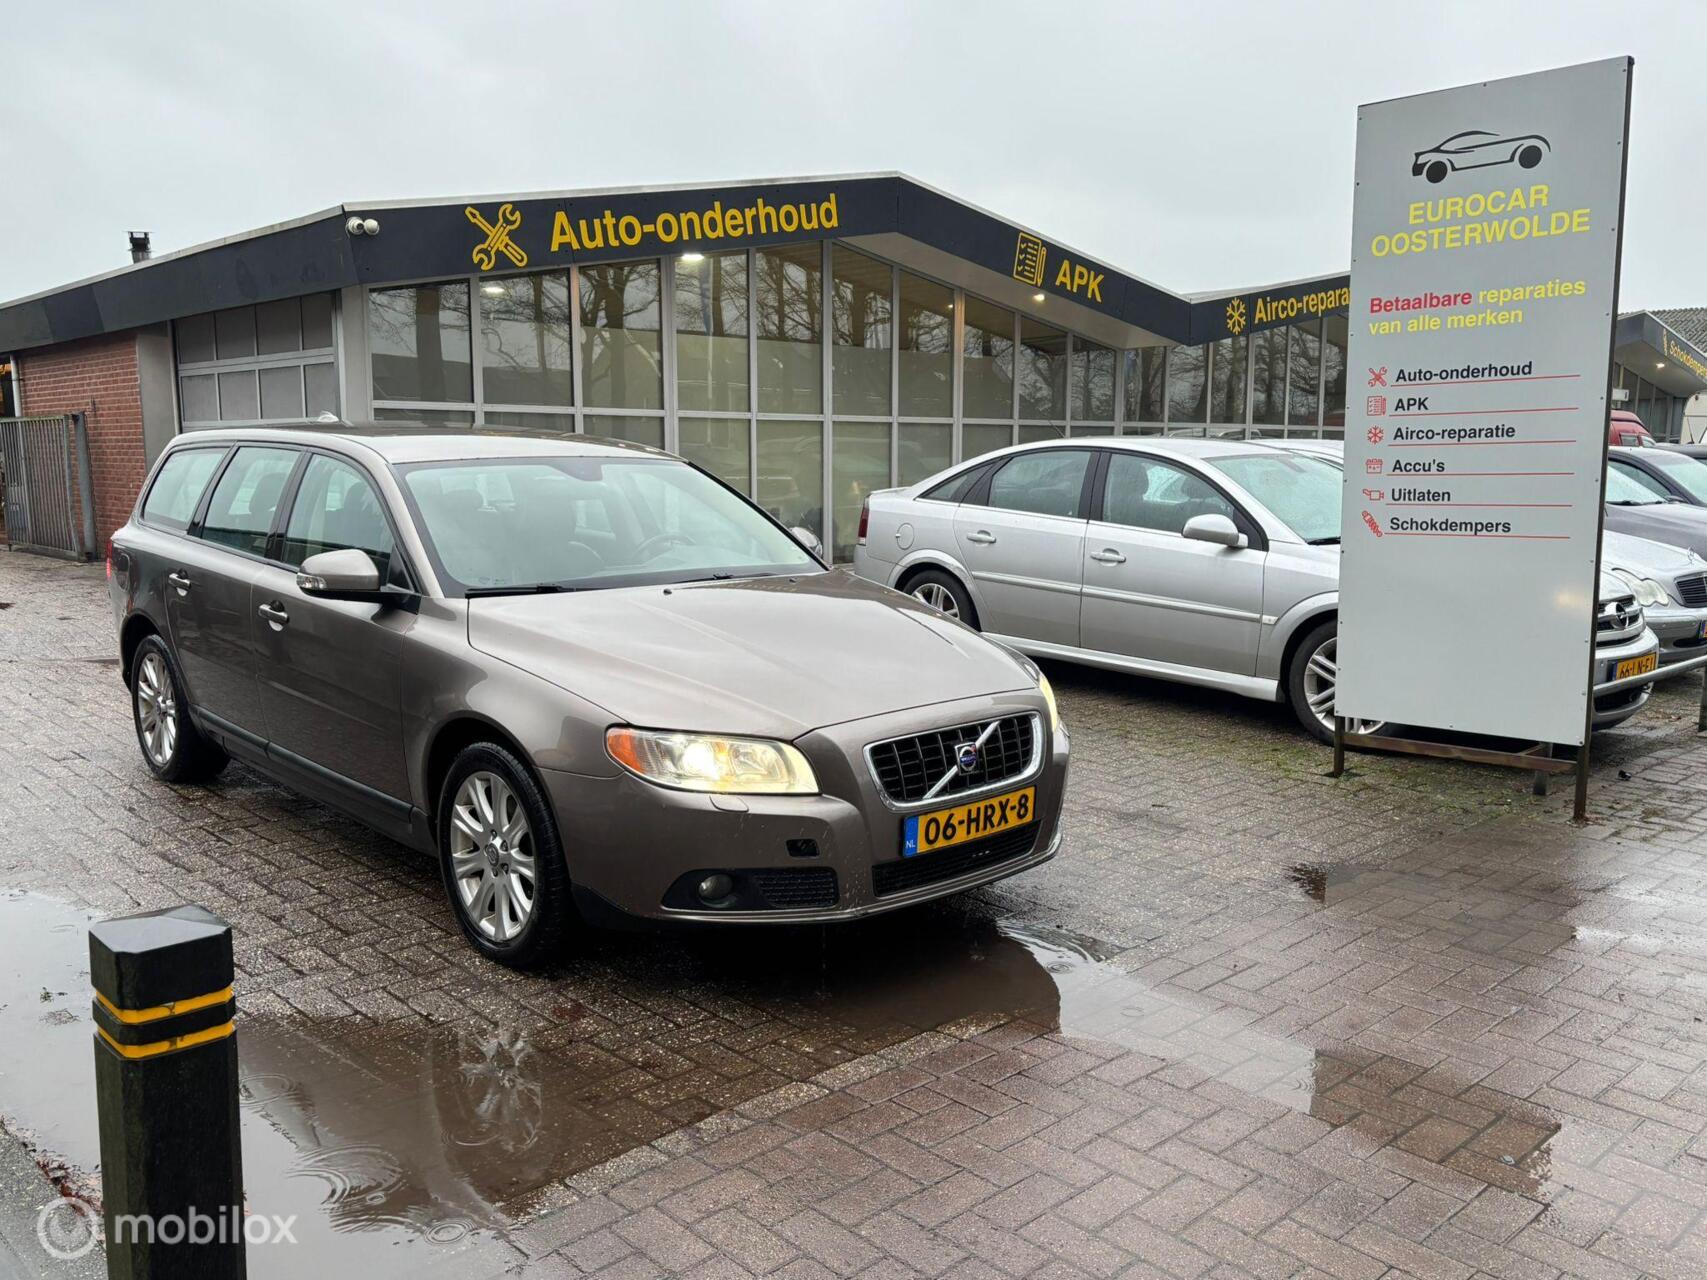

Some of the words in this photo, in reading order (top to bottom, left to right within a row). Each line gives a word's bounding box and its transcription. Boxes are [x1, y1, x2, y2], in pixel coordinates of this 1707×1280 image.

[1408, 184, 1549, 226] EUROCAR
[550, 193, 838, 251] Auto-onderhoud
[1371, 208, 1591, 257] OOSTERWOLDE
[1055, 259, 1105, 303] APK
[1369, 290, 1473, 314] Betaalbare
[1478, 279, 1586, 307] reparaties
[1254, 286, 1351, 324] Airco-repara
[1369, 319, 1401, 336] van
[1407, 315, 1441, 332] alle
[1446, 307, 1523, 329] merken
[1395, 361, 1533, 383] Auto-onderhoud
[1394, 397, 1430, 412] APK
[1393, 424, 1516, 442] Airco-reparatie
[1392, 459, 1445, 473] Accu's
[1391, 488, 1451, 502] Uitlaten
[1389, 517, 1512, 535] Schokdempers
[905, 840, 916, 849] NL
[924, 793, 1030, 846] 06-HRX-8
